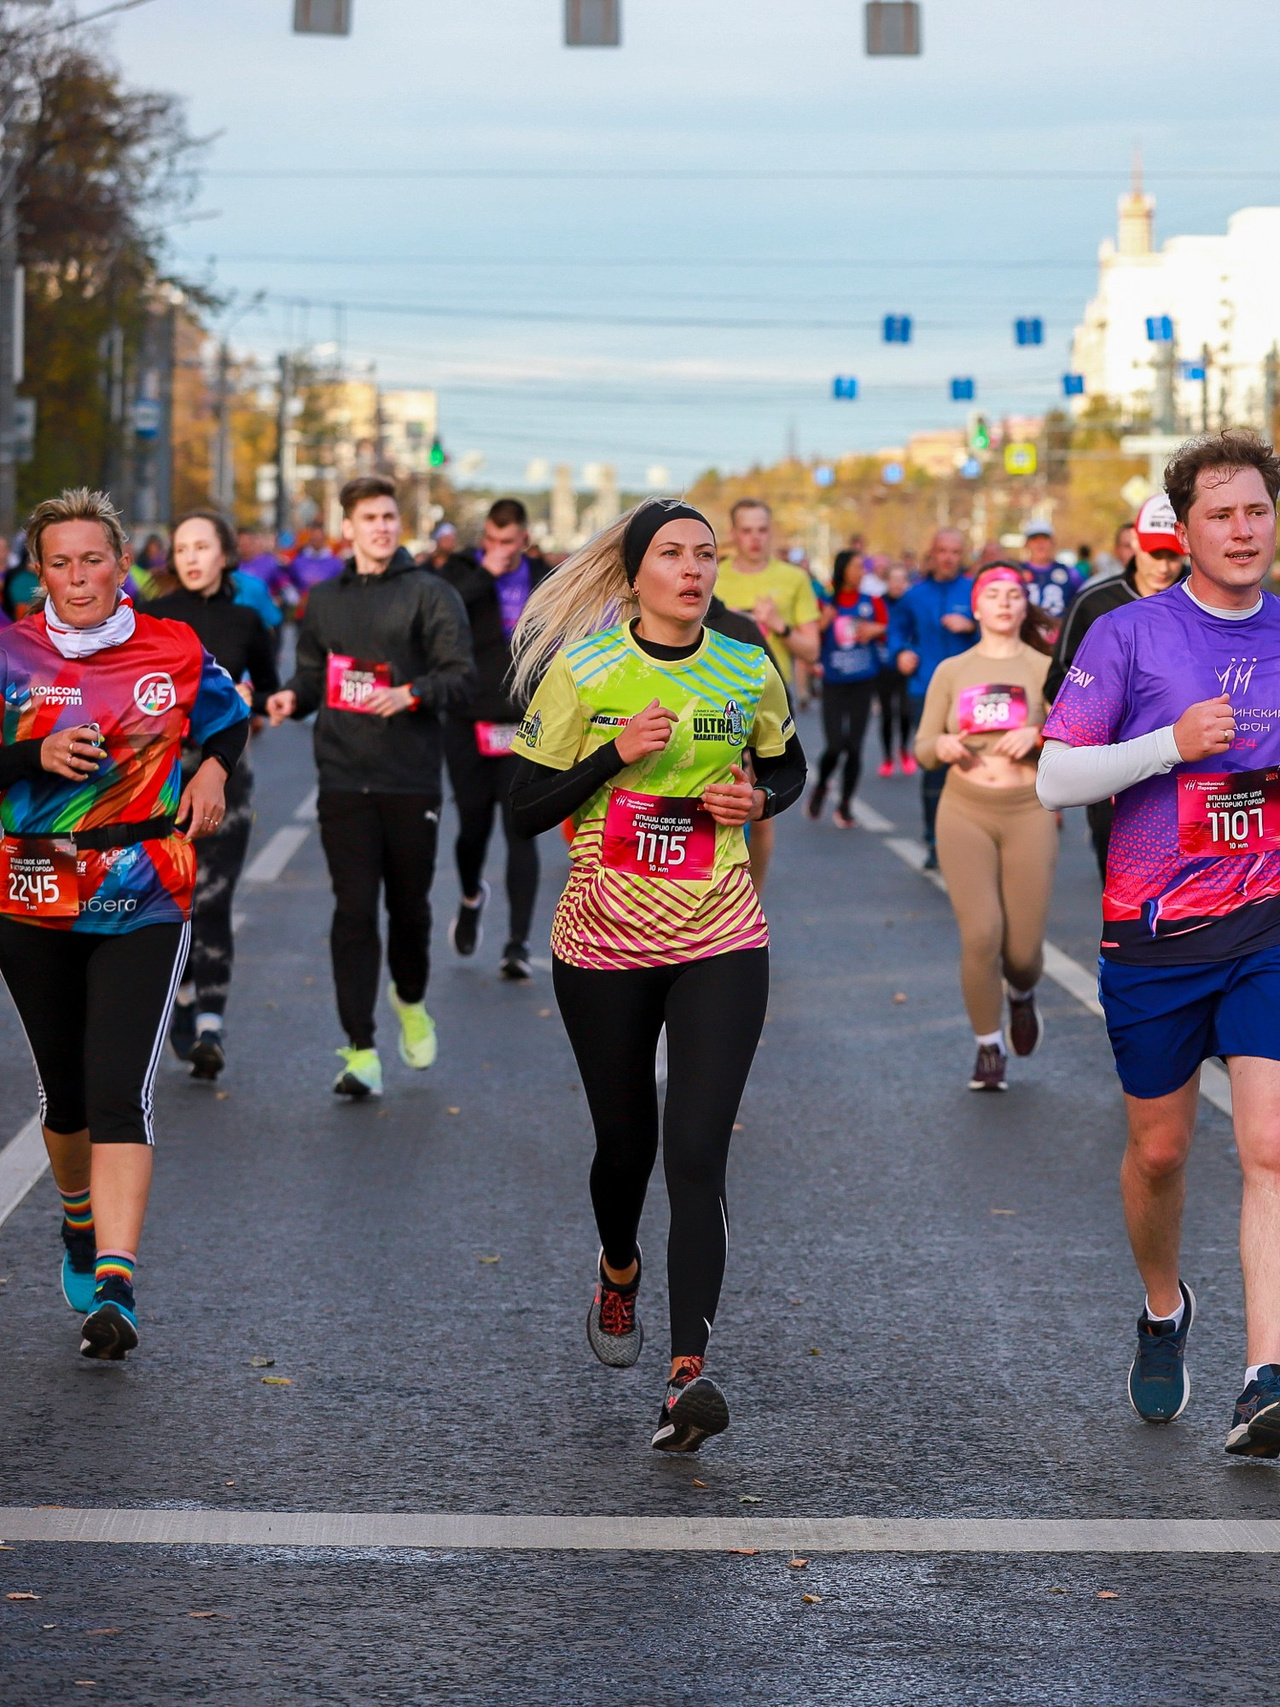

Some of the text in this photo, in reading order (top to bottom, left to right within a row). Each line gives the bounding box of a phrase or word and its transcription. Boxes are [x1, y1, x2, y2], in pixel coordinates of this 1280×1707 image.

[31, 686, 82, 696] КОНСОМ
[45, 695, 83, 706] ГРУПП
[973, 702, 1010, 724] 968
[693, 718, 733, 733] ULTRA
[693, 733, 726, 741] MARATHON
[1233, 792, 1249, 800] СВОЕ
[1250, 790, 1262, 798] ИМЯ
[1244, 798, 1265, 806] ГОРОДА
[635, 813, 659, 823] ВПИШИ
[638, 821, 670, 832] ИСТОРИЮ
[635, 831, 687, 865] 1115
[649, 864, 656, 872] 10
[8, 872, 60, 904] 2245
